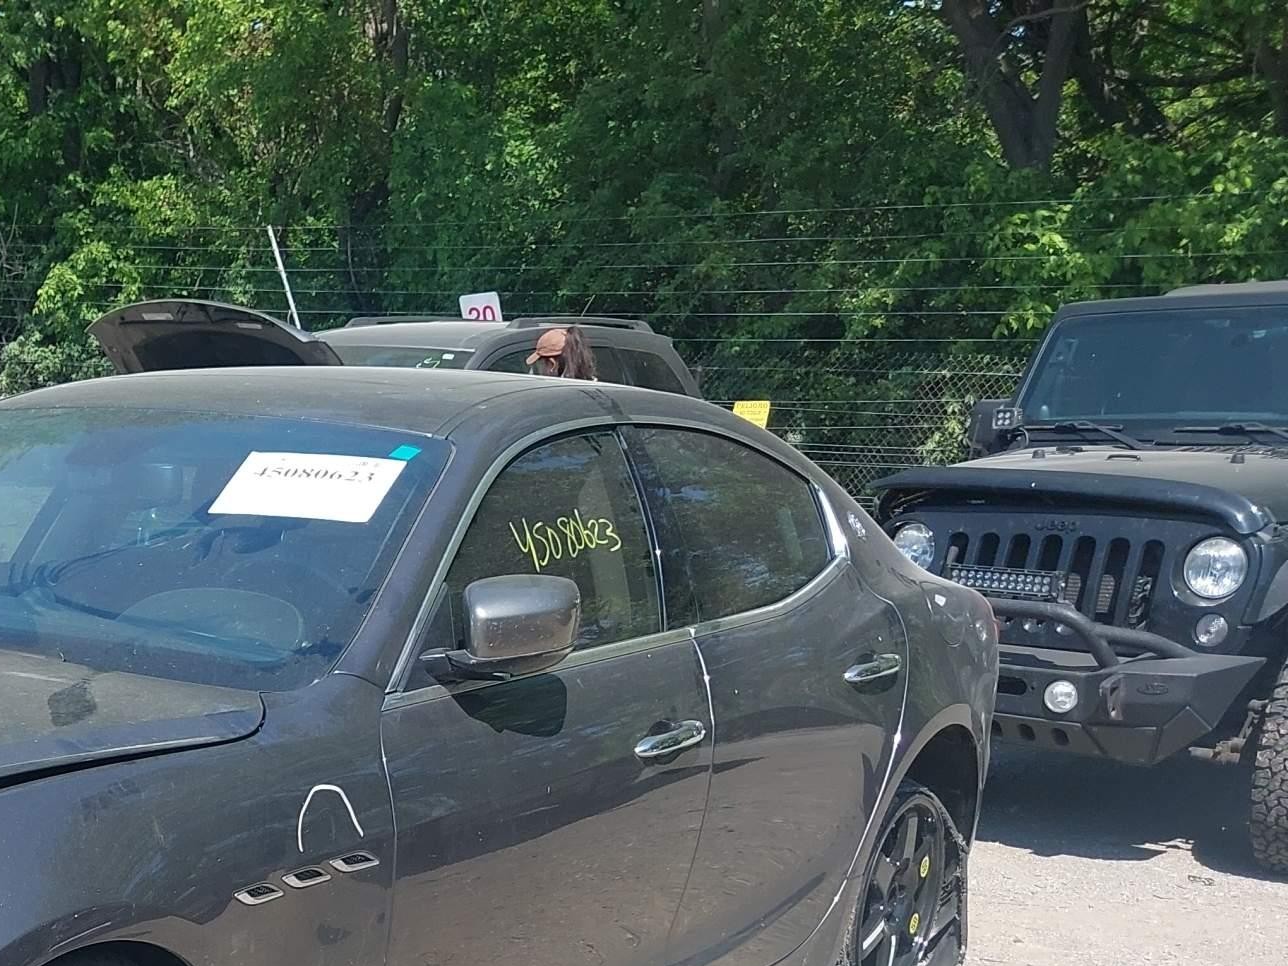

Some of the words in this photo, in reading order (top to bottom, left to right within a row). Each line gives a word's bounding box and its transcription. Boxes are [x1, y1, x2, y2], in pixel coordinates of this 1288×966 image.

[468, 305, 496, 321] 20
[253, 465, 376, 483] 45080623
[1034, 518, 1079, 534] Jeep
[509, 508, 622, 573] 45080623
